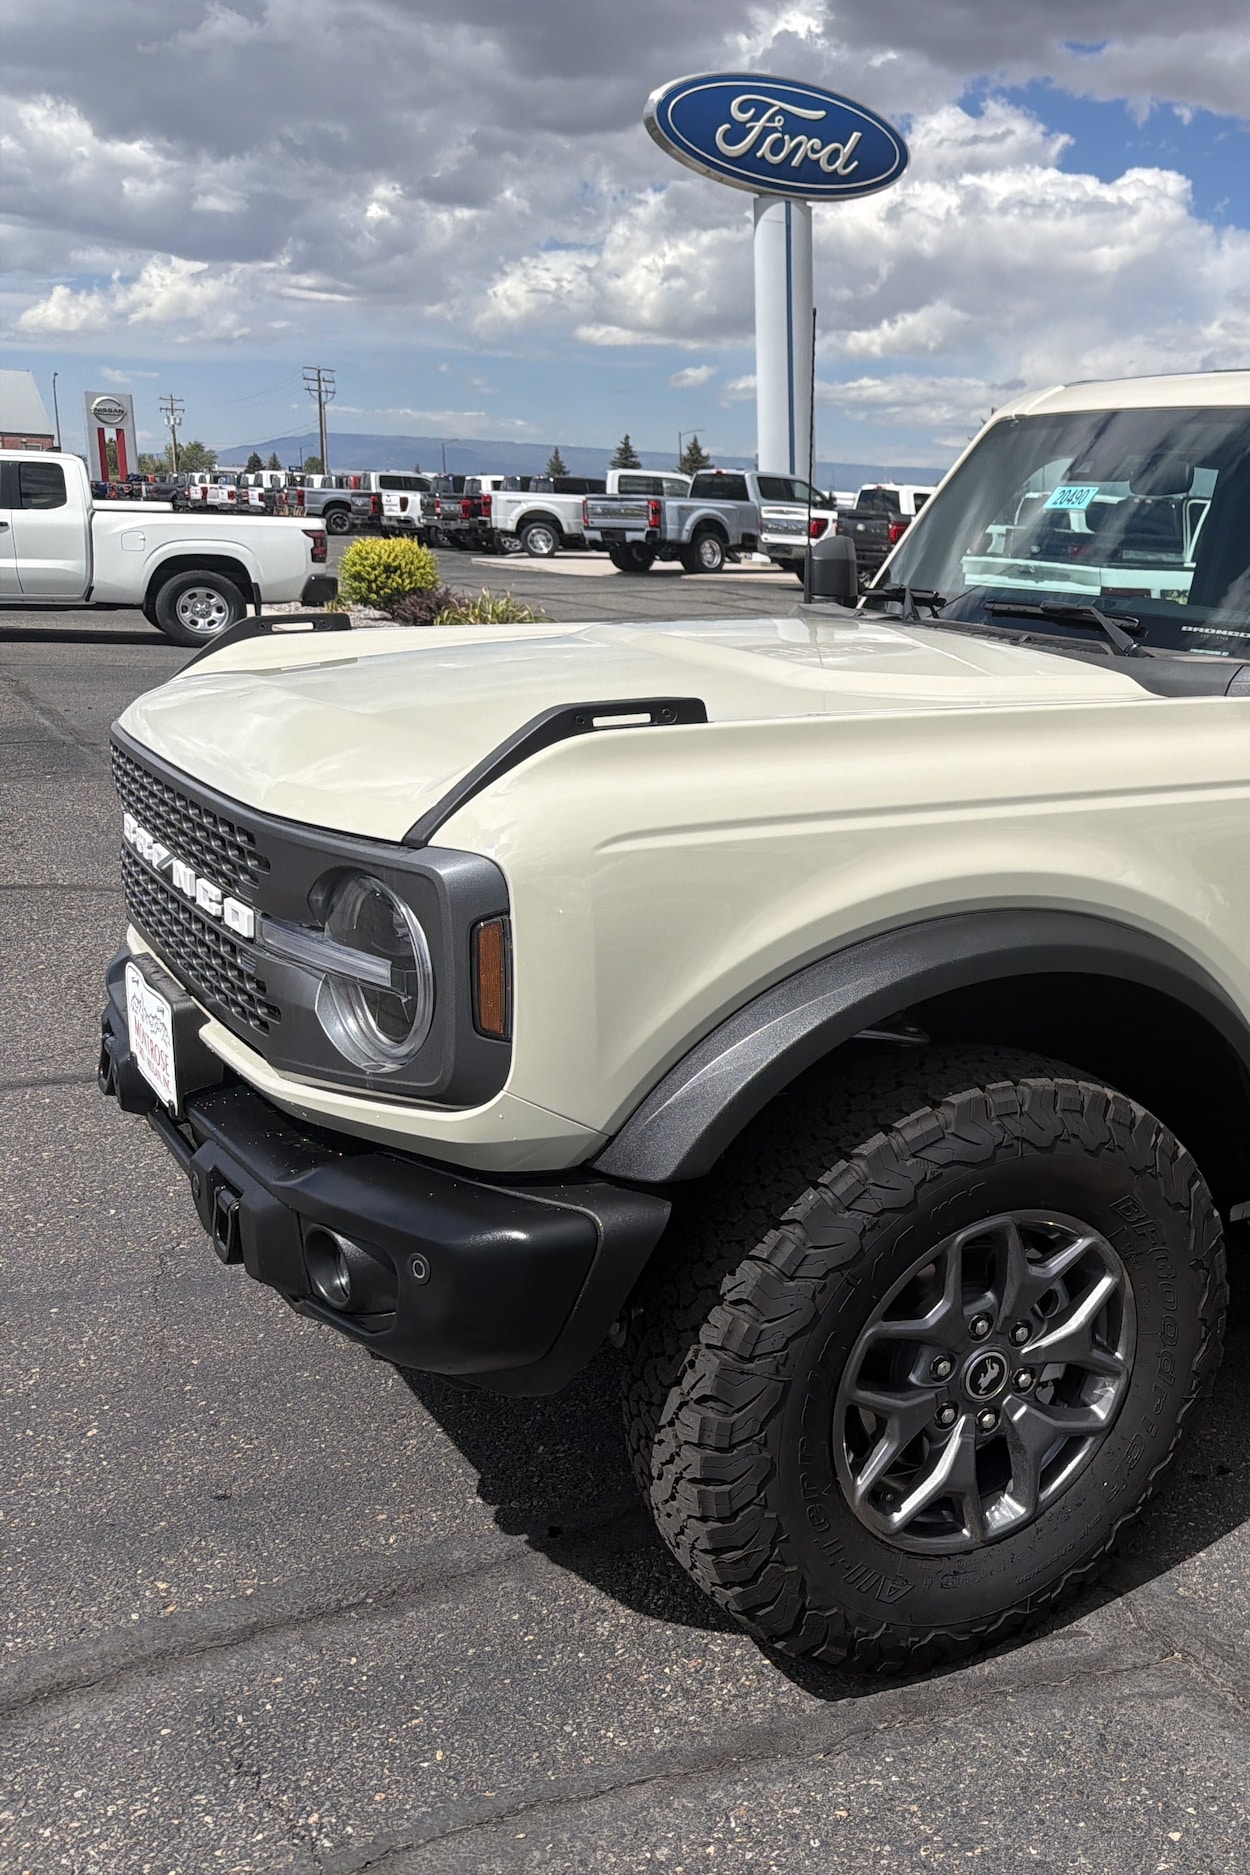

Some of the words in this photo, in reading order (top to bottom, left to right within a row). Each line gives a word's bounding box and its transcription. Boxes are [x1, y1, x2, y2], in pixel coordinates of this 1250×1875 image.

[714, 94, 863, 177] Ford
[1051, 488, 1091, 505] 20490
[123, 812, 255, 938] BRONCO
